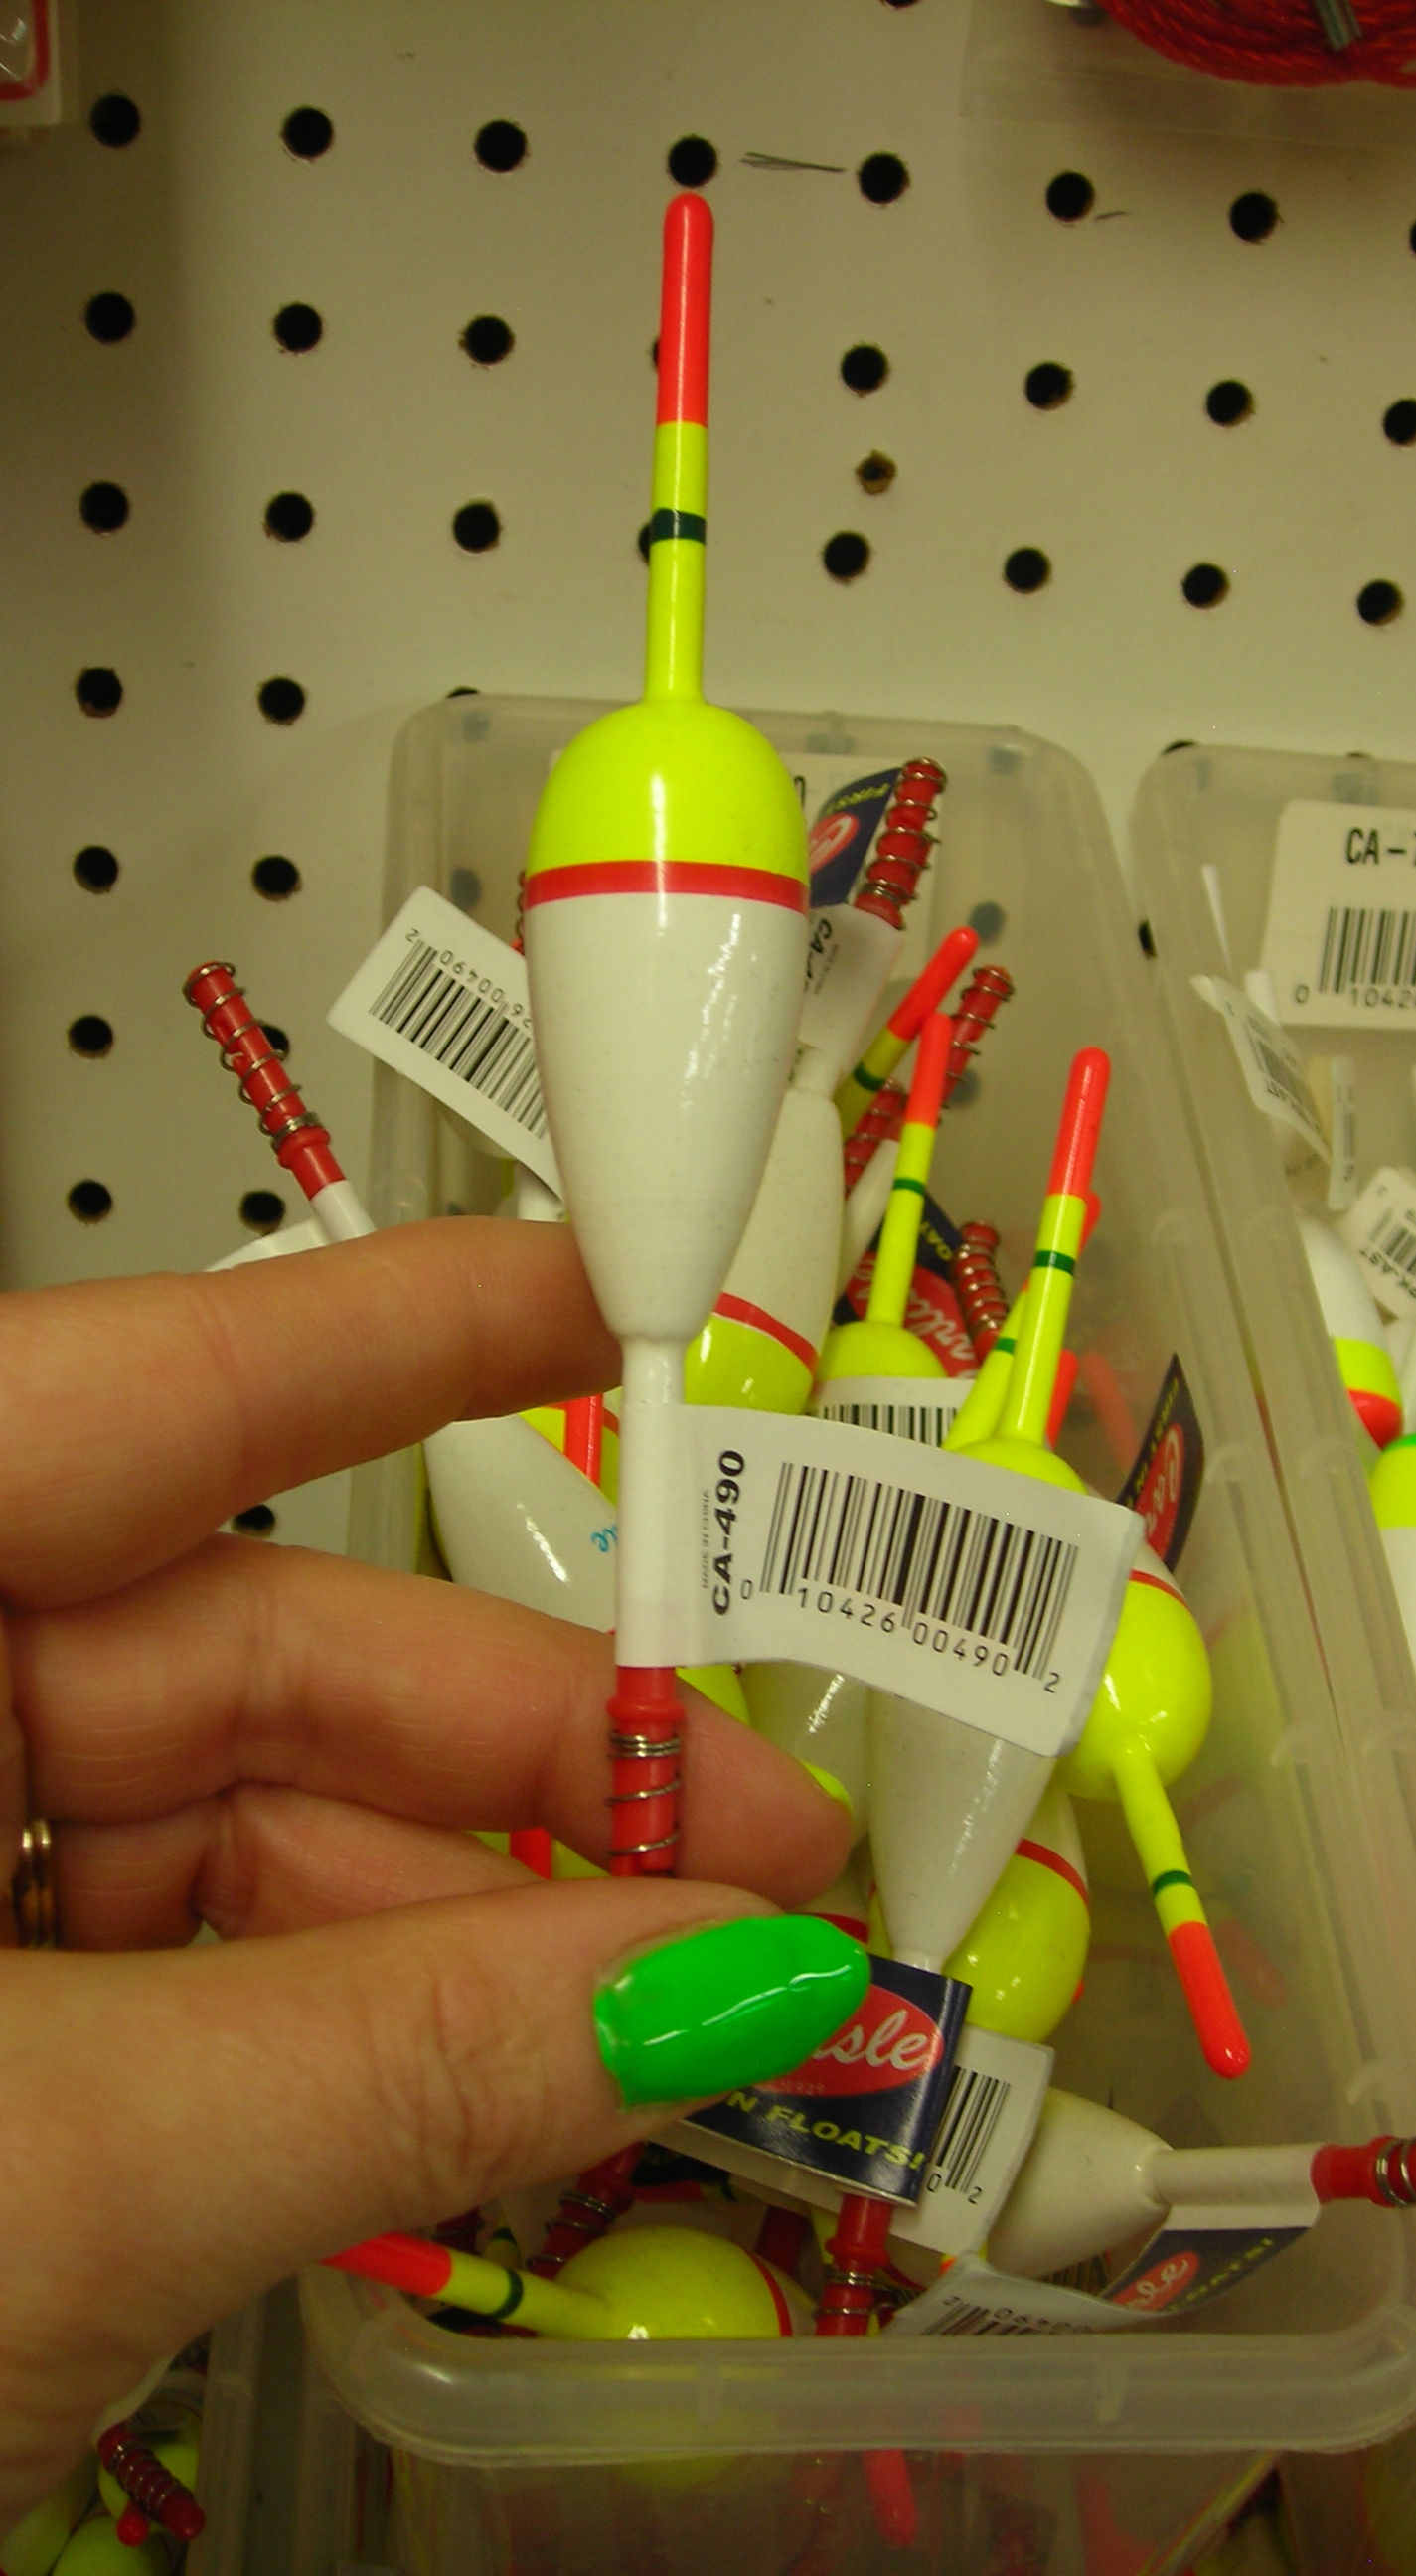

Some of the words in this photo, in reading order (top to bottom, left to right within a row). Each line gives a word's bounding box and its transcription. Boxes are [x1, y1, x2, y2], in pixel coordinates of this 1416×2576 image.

[1344, 826, 1416, 865] CA-
[404, 927, 420, 944] 2
[438, 949, 506, 1004] 00490
[1350, 986, 1416, 1010] 1042
[711, 1449, 745, 1617] CA-490
[740, 1578, 754, 1600] 0
[797, 1586, 896, 1634] 10426
[912, 1621, 1010, 1678] 00490
[1043, 1672, 1061, 1694] 2
[724, 2091, 757, 2114] N
[764, 2104, 927, 2171] FLOATS!
[967, 2186, 983, 2205] 2
